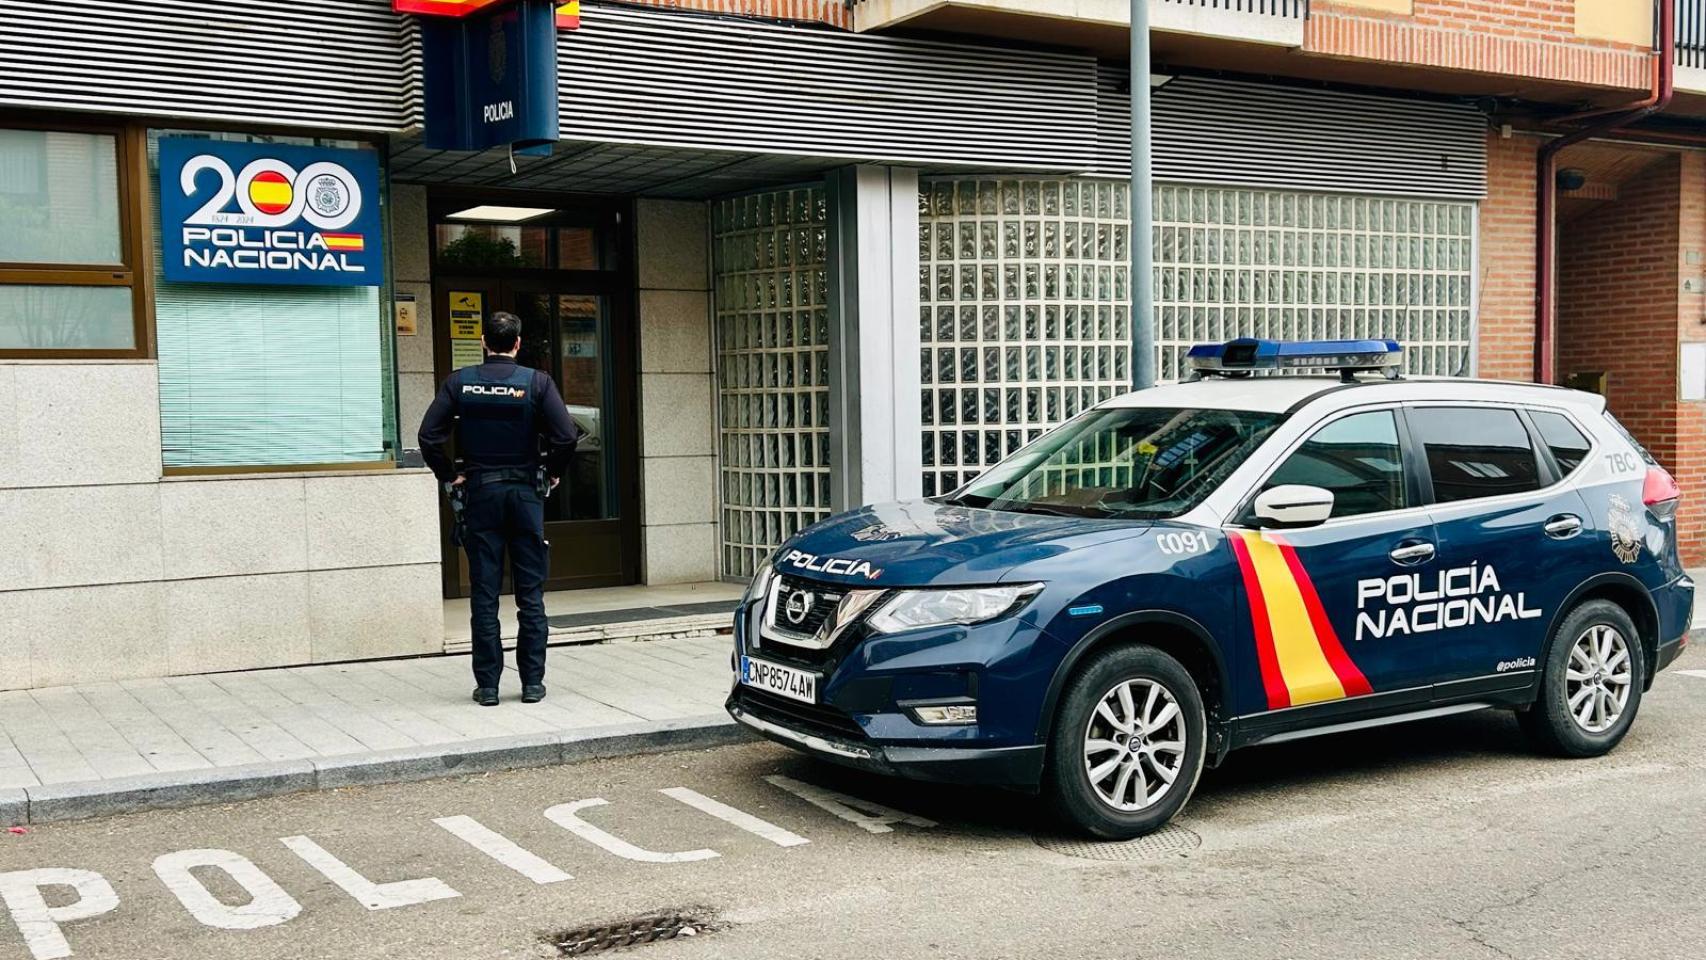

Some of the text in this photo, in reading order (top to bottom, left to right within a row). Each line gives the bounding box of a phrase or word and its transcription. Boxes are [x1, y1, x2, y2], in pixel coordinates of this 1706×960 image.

[180, 154, 362, 230] 200
[184, 249, 365, 272] NACIONAL
[1605, 452, 1636, 474] 7BC
[783, 550, 871, 576] POLICÍA
[1357, 560, 1501, 609] POLICÍA
[1355, 592, 1543, 641] NACIONAL
